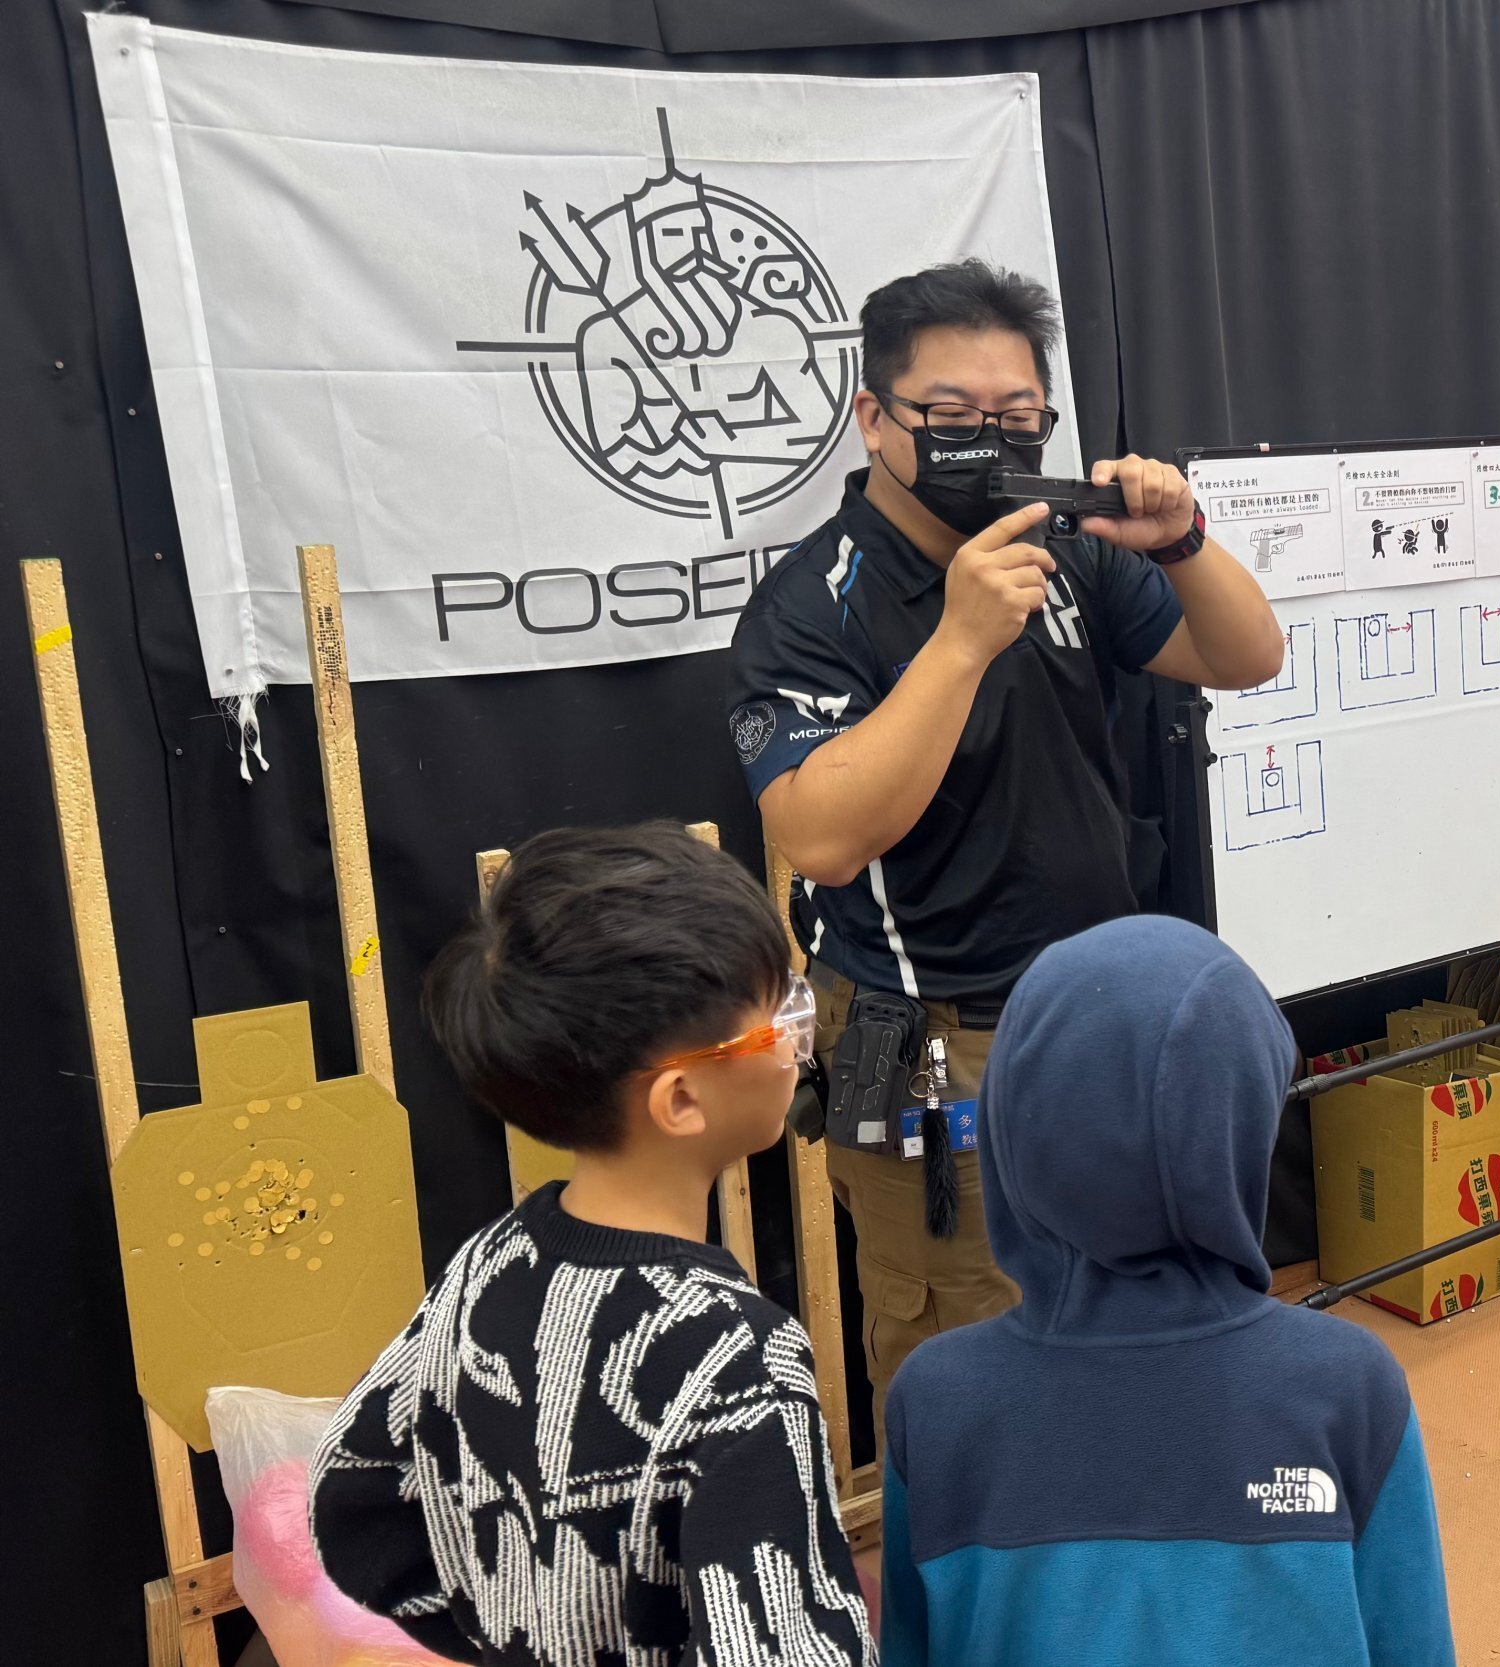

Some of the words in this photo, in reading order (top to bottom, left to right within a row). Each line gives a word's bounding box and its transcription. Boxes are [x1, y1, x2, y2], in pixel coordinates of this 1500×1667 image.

[1197, 477, 1259, 490] 用槍四大安全法則
[1245, 509, 1260, 517] guns
[1276, 504, 1297, 513] always
[1273, 1467, 1308, 1483] THE
[1246, 1482, 1307, 1499] NORTH
[1261, 1498, 1306, 1514] FACE
